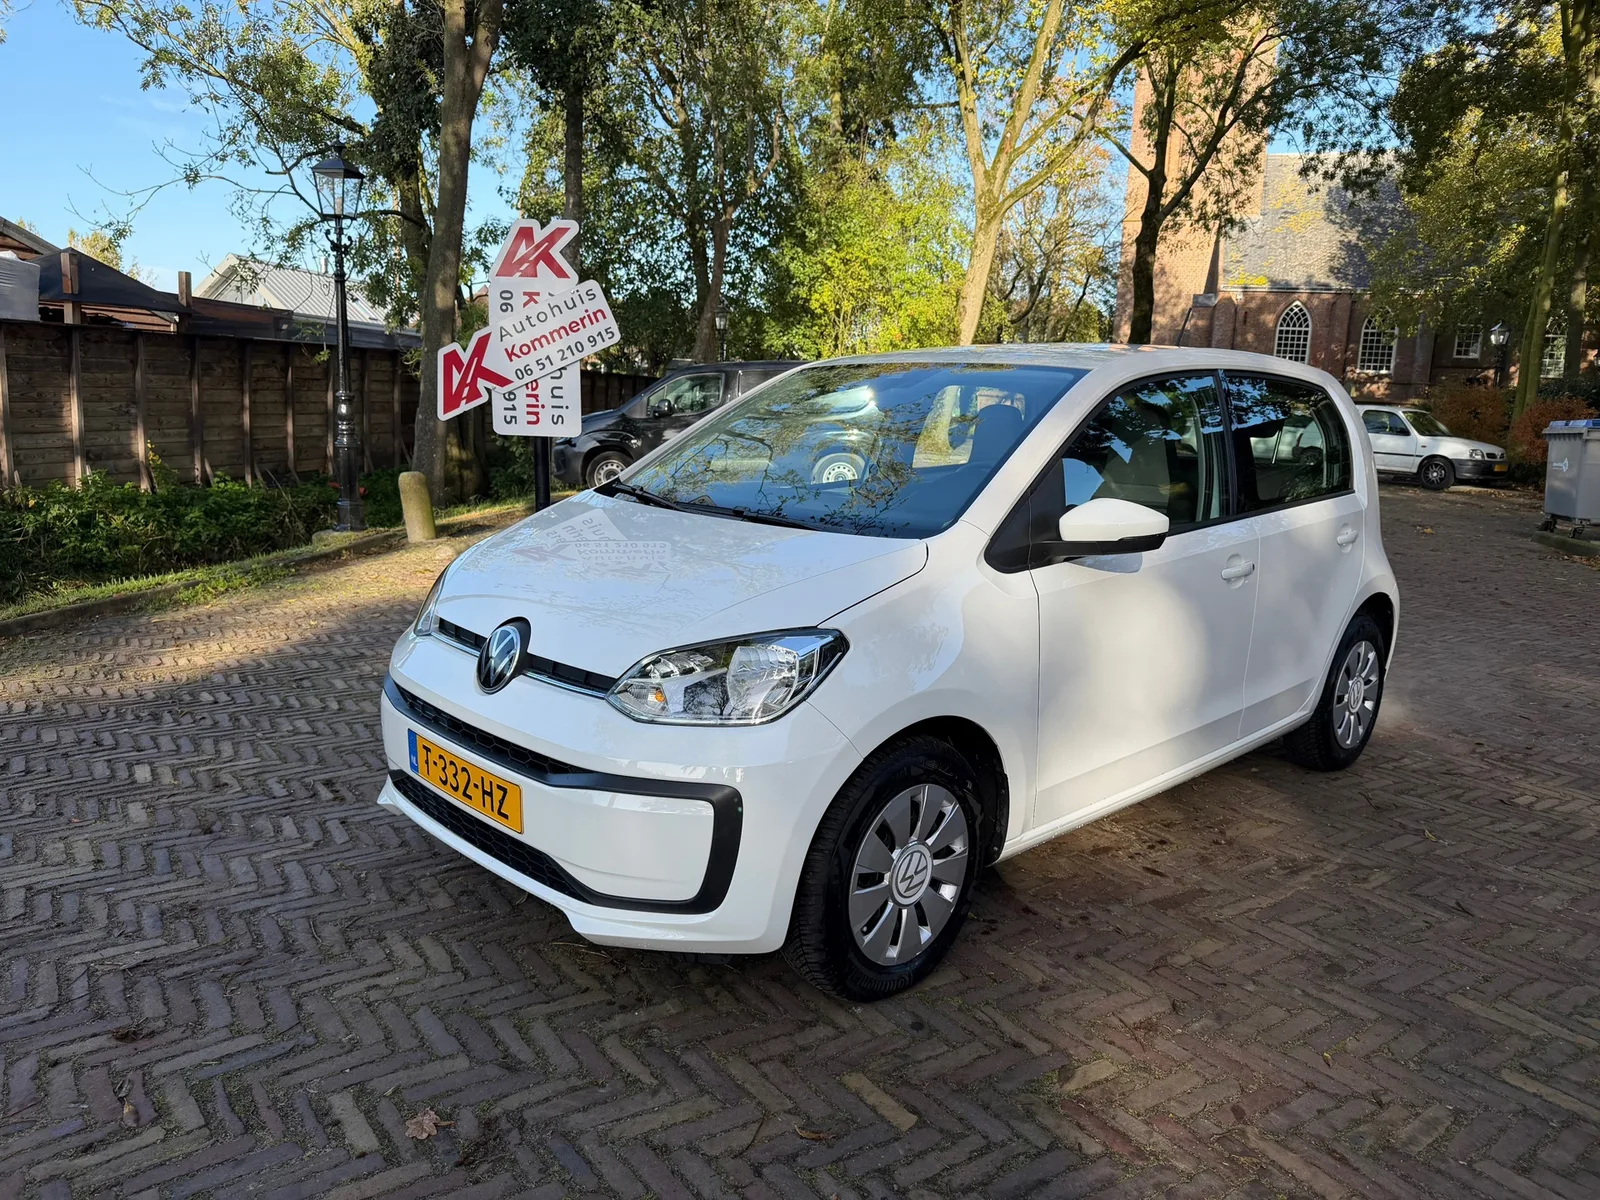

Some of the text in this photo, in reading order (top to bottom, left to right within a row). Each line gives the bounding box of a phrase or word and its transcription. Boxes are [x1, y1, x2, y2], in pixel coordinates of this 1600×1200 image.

[499, 288, 596, 342] Autohuis
[500, 289, 514, 313] 06
[504, 308, 607, 362] Kommerin
[514, 326, 615, 380] 06 51 210 915
[422, 744, 509, 820] T-332-HZ
